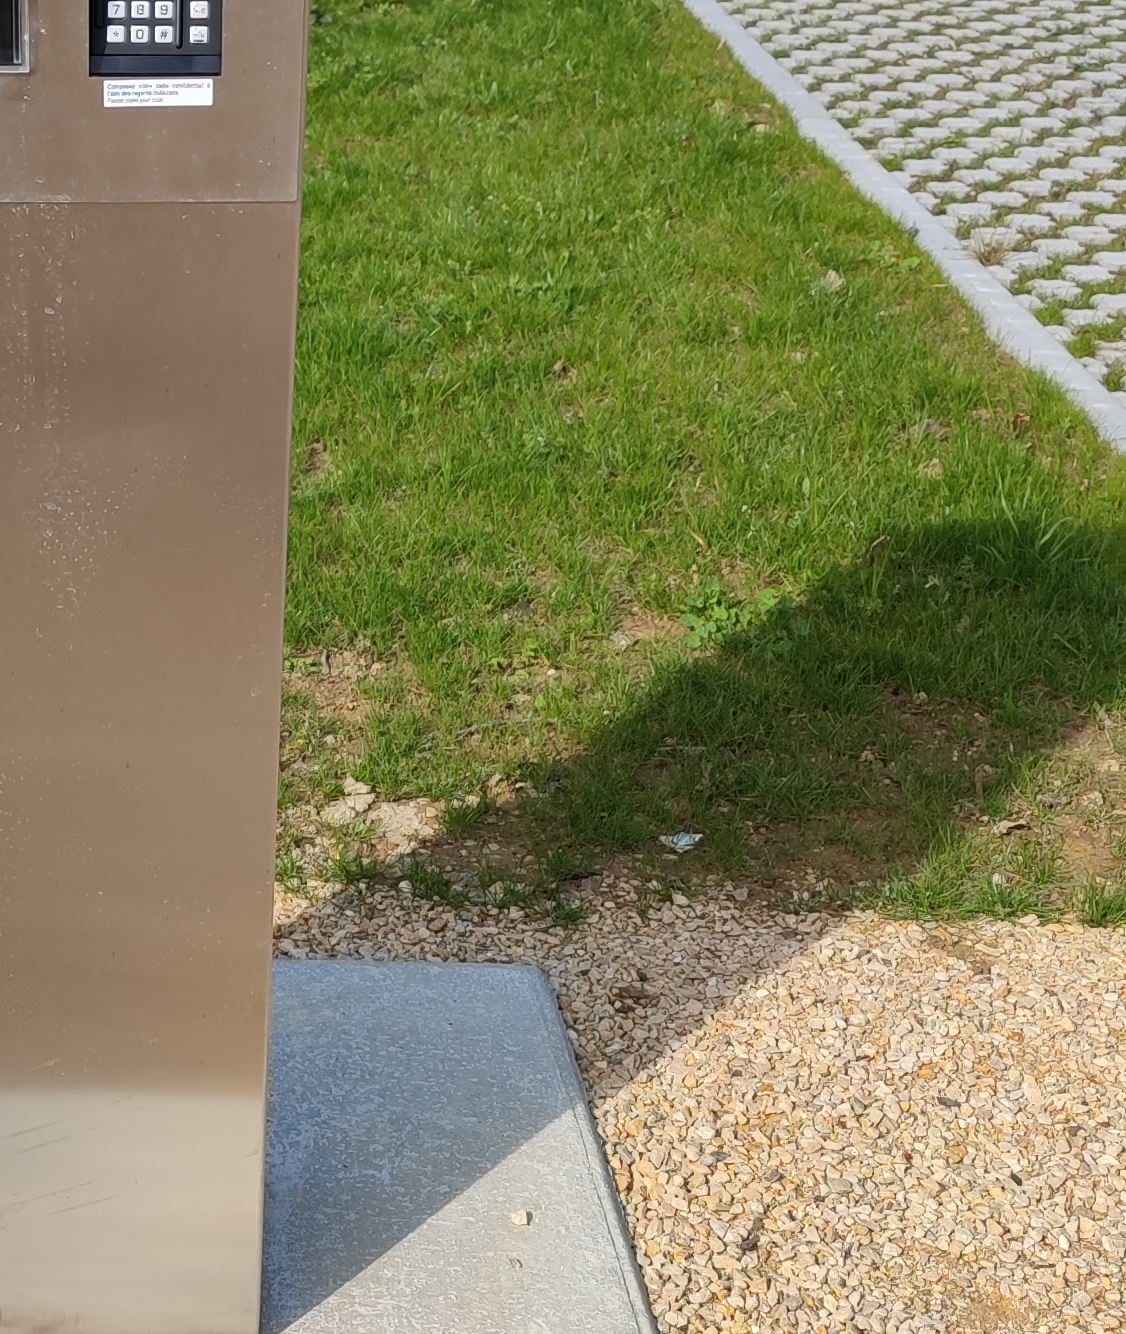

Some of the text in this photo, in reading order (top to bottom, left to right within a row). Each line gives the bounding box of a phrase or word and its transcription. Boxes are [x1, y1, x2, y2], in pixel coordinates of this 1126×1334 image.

[112, 4, 169, 15] 7 8 9
[135, 29, 144, 39] 0
